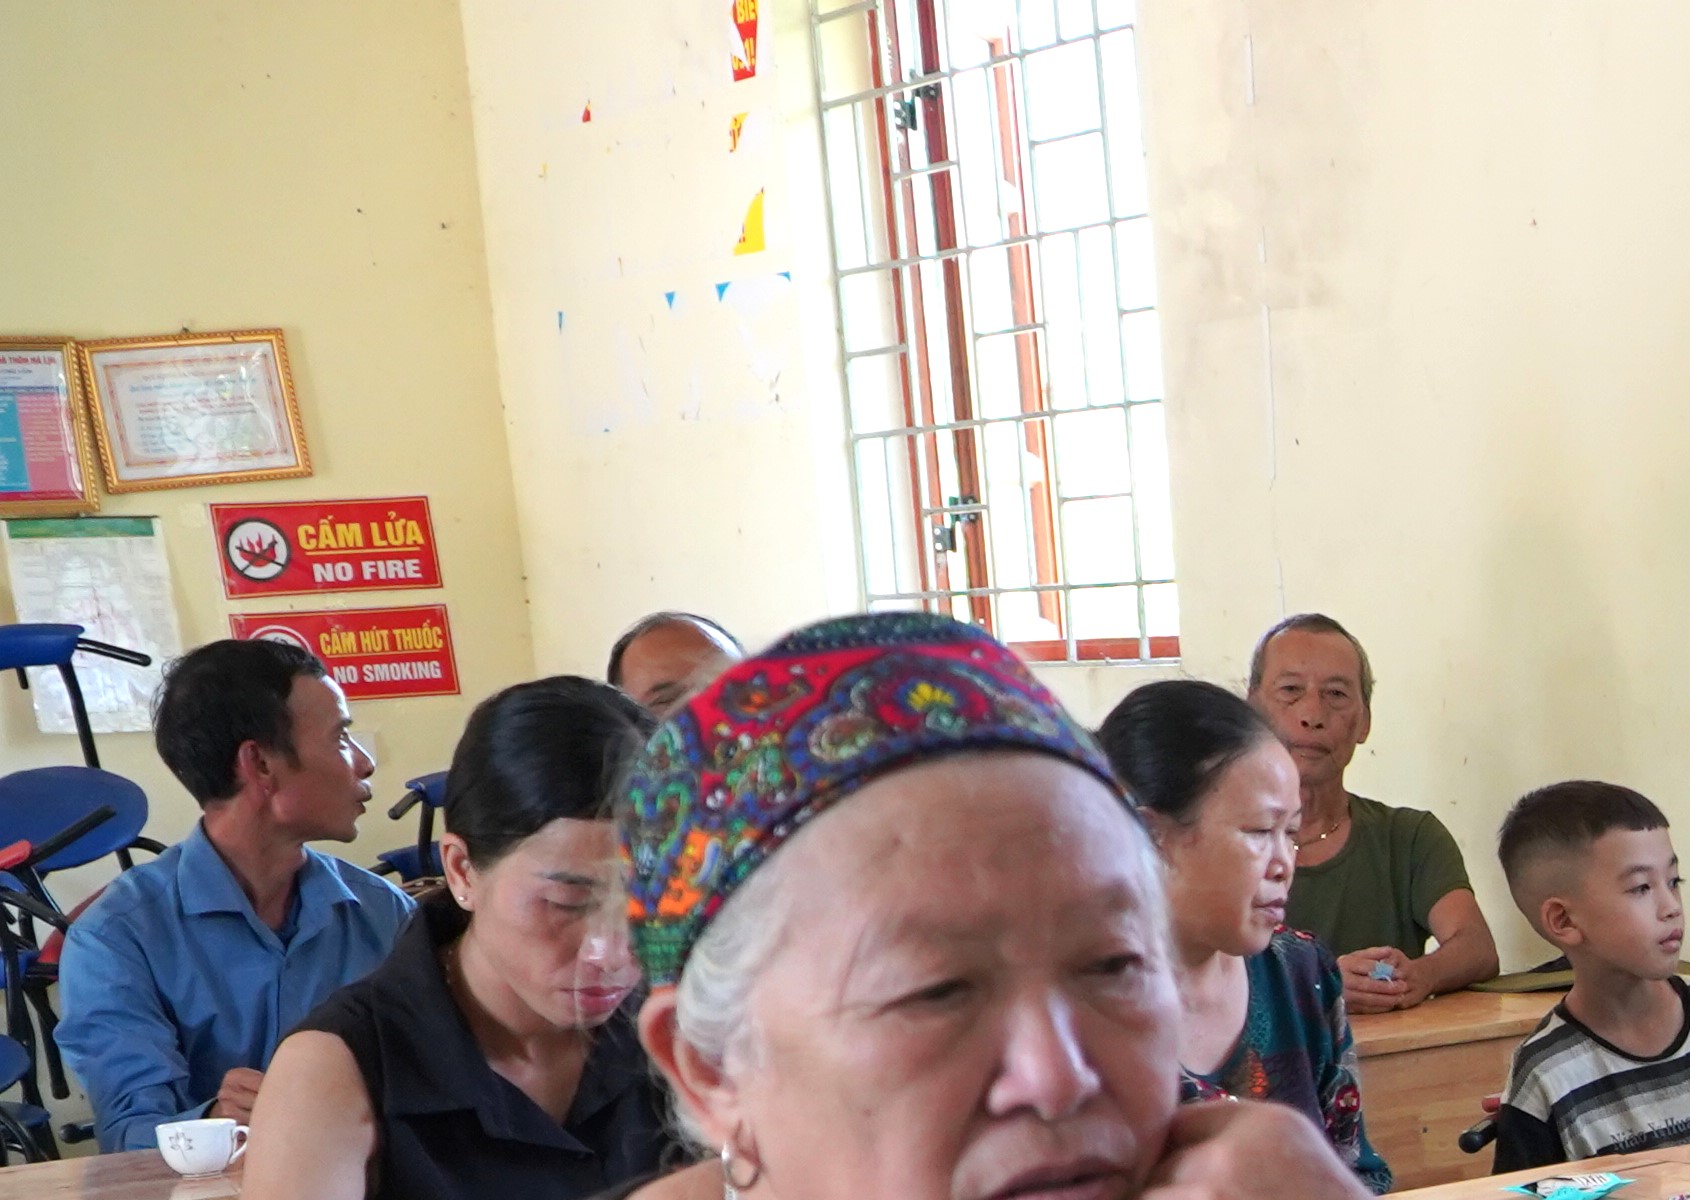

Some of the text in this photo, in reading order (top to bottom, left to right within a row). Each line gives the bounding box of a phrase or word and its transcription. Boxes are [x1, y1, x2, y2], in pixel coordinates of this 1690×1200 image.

[297, 511, 425, 550] CẤM LỬA
[312, 559, 423, 583] NO FIRE
[319, 619, 444, 656] CẤM HÚT THUỐC
[332, 661, 442, 684] NO SMOKING
